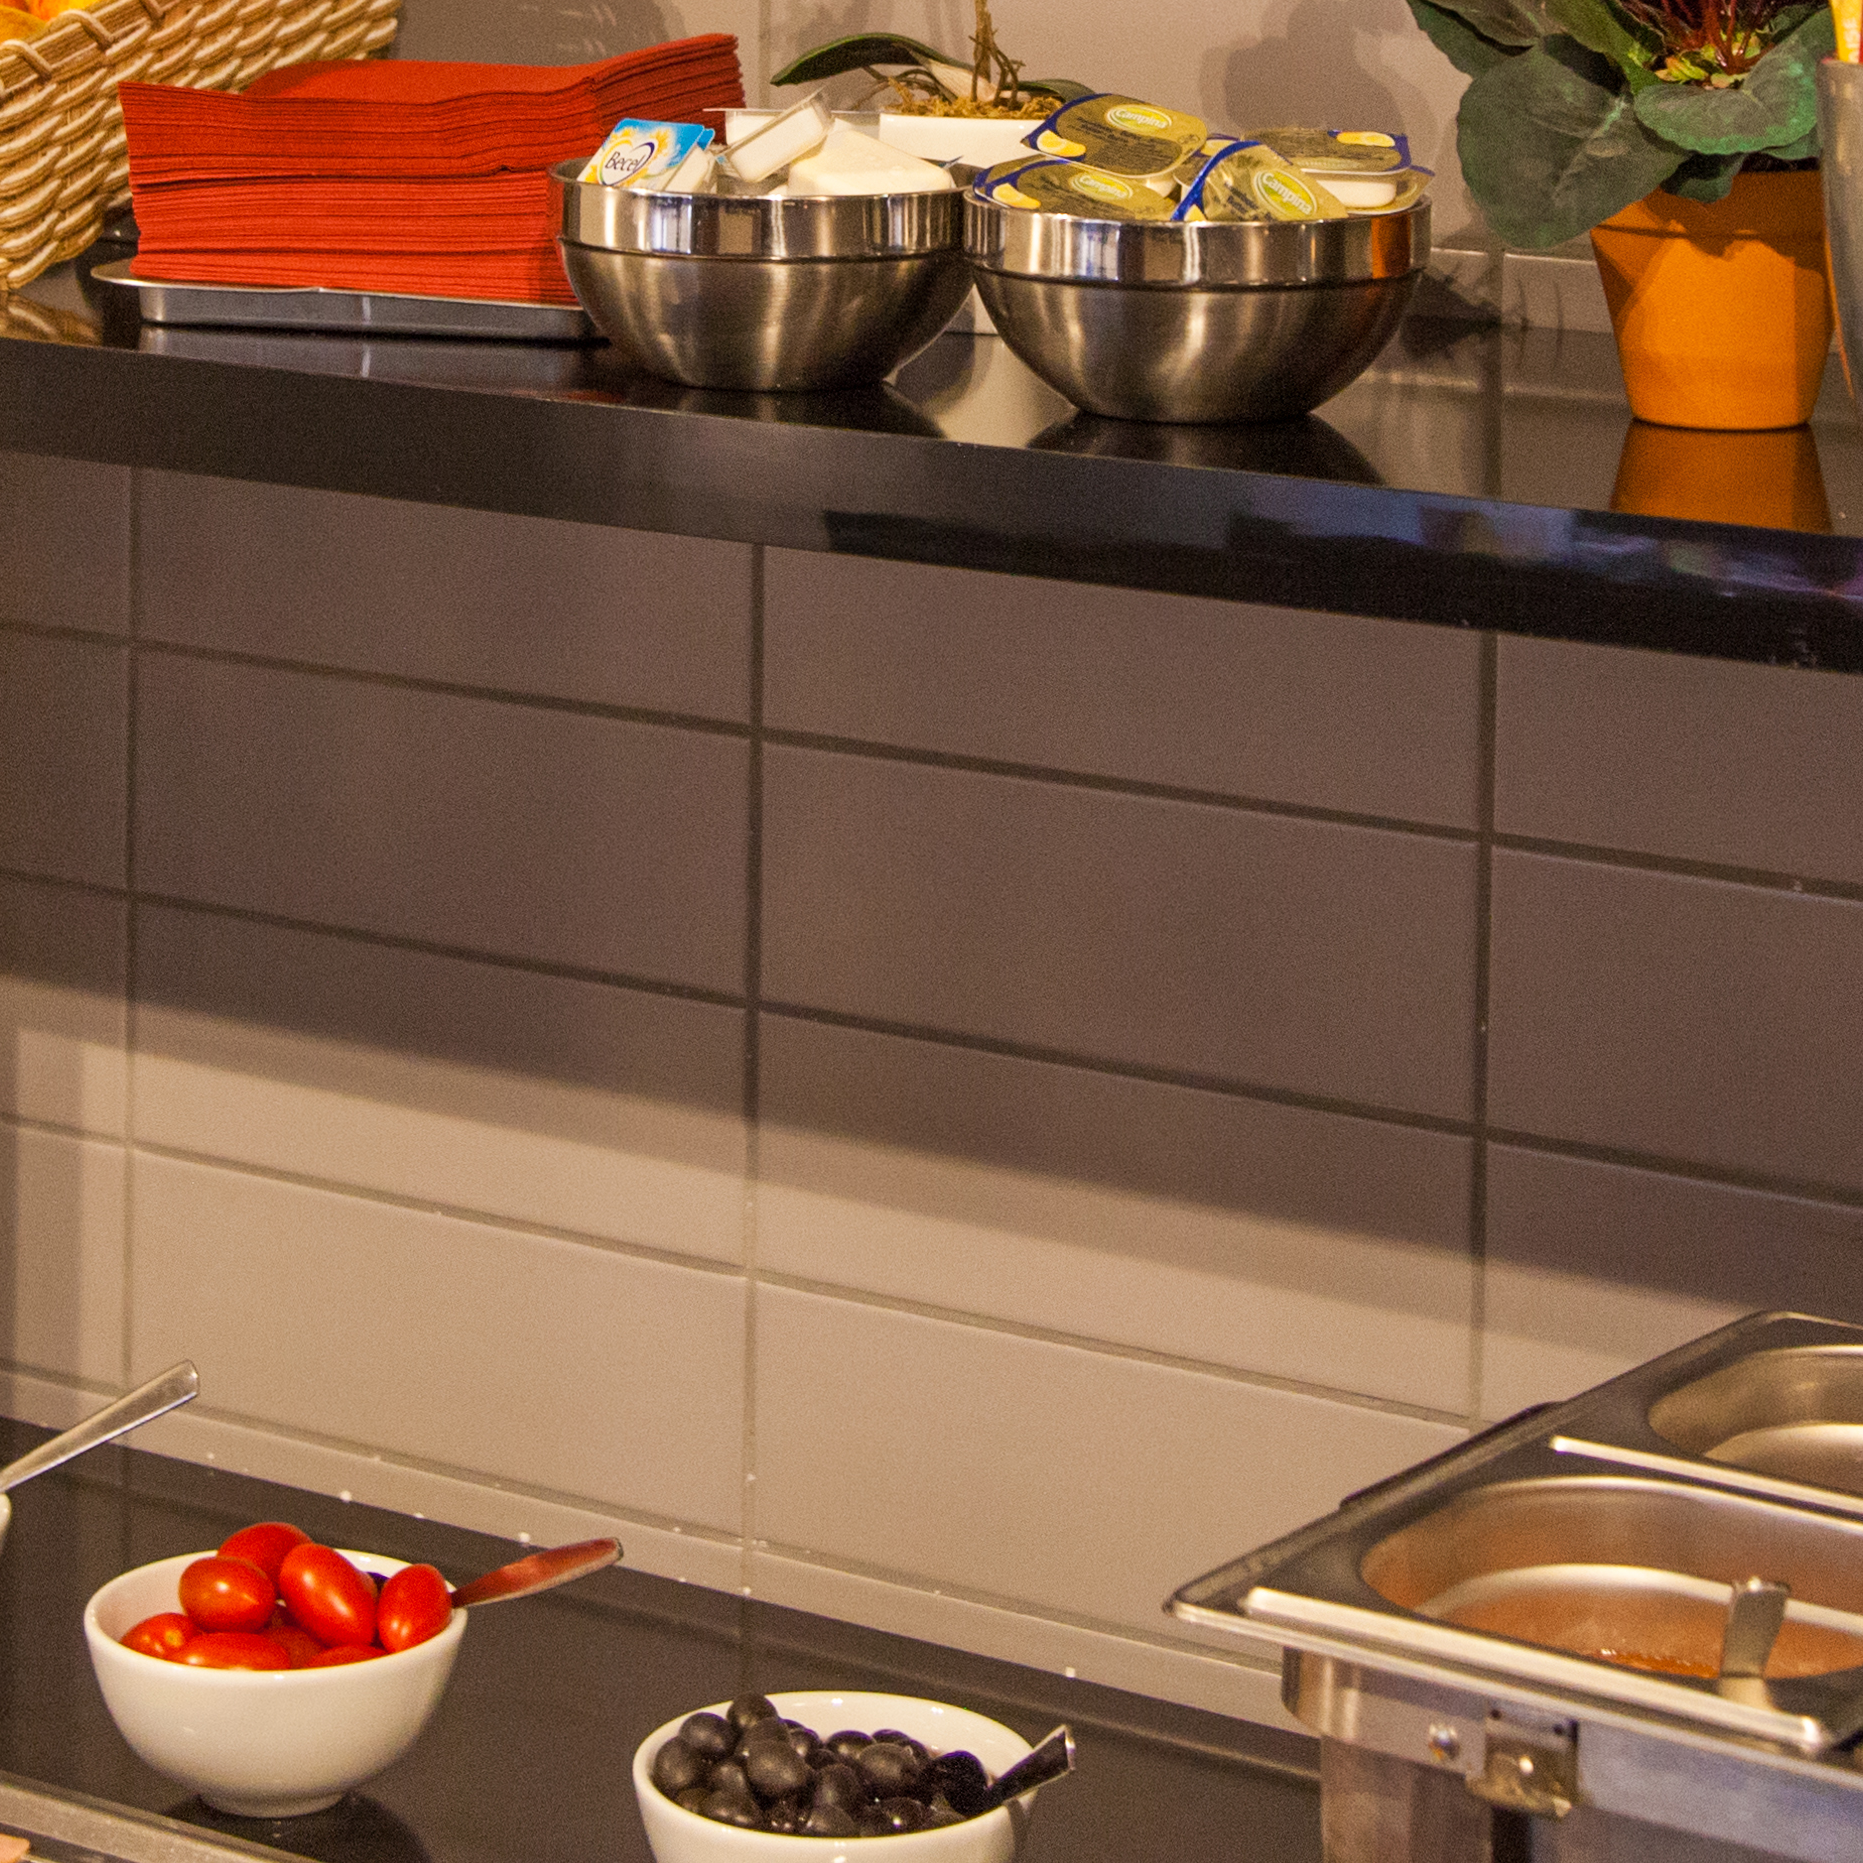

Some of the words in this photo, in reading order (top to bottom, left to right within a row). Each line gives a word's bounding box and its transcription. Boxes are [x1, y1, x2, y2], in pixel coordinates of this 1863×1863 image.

[1114, 107, 1169, 131] Campina
[604, 150, 646, 173] Becel
[1079, 172, 1129, 199] Campina
[1261, 171, 1313, 217] Campina
